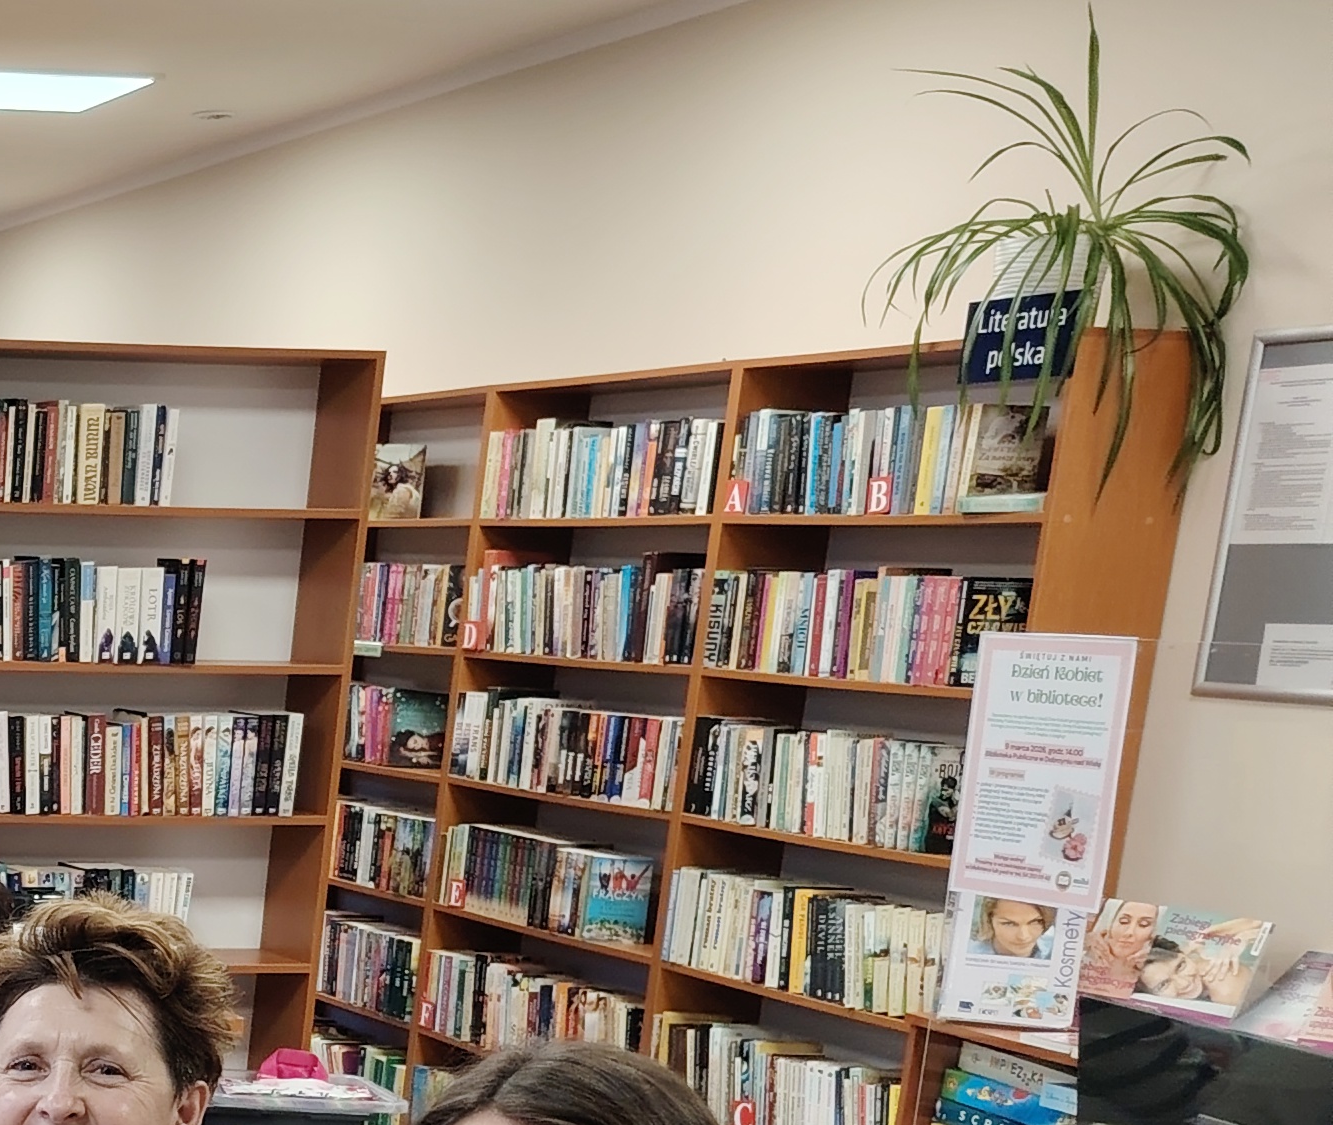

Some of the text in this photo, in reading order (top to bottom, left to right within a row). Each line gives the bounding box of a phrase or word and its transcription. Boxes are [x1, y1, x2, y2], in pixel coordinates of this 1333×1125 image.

[84, 416, 100, 503] IWAN BUNIN
[724, 484, 743, 512] A
[870, 480, 888, 511] B
[464, 623, 477, 648] D
[1019, 650, 1057, 661] ŚWIĘTUJ
[1011, 664, 1104, 683] Dzień Kobiet
[1027, 689, 1103, 708] bibliotece!
[89, 733, 102, 775] CEDER
[451, 881, 462, 905] E
[816, 914, 826, 954] DEVIL
[1170, 913, 1212, 931] Zabiegi
[420, 1002, 432, 1027] F
